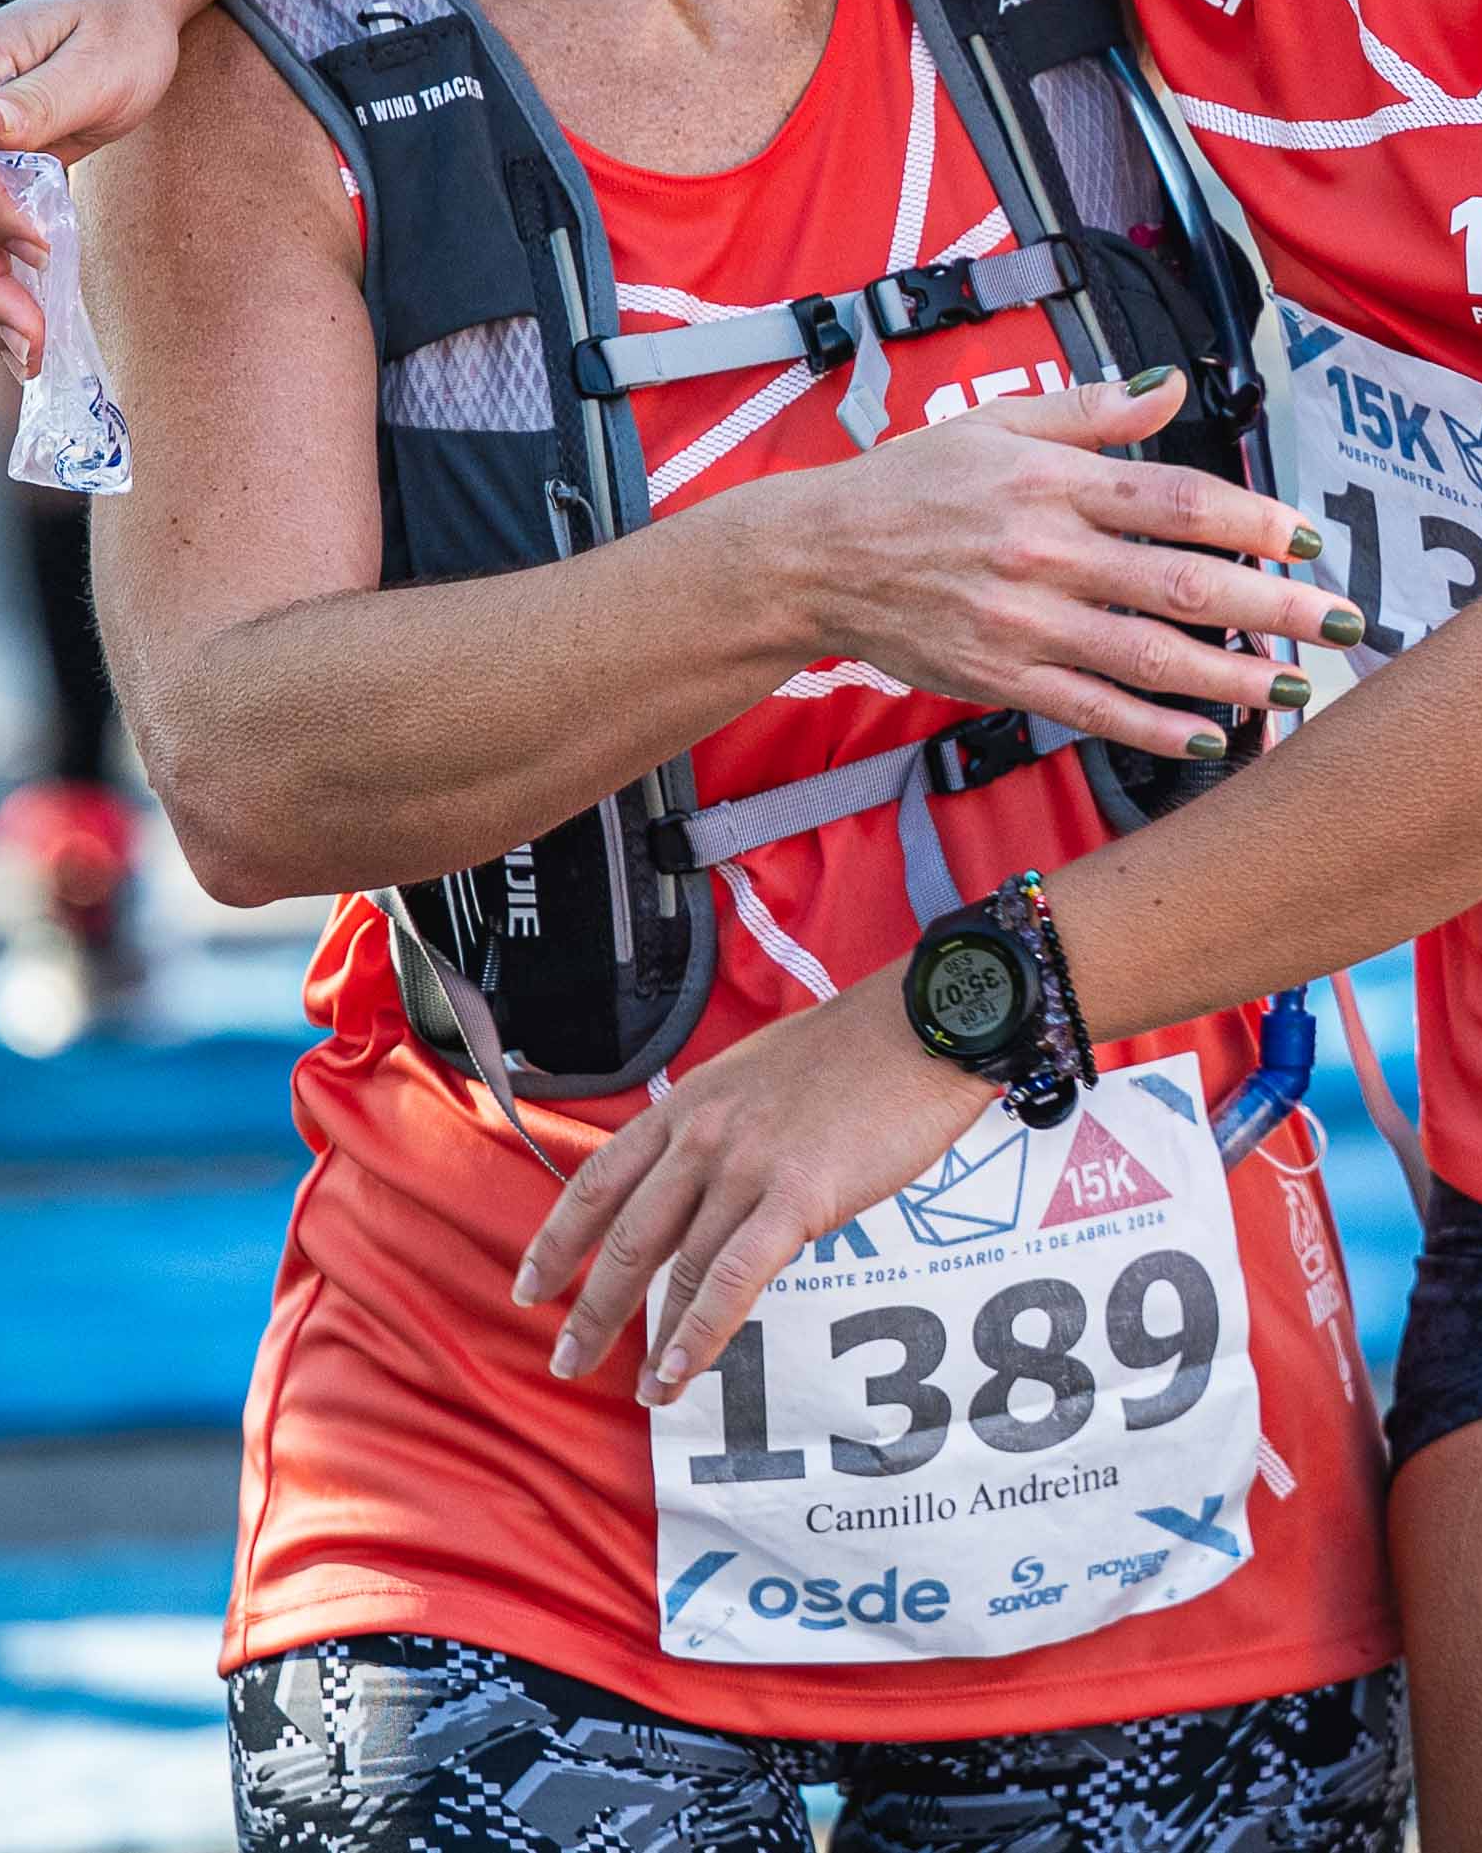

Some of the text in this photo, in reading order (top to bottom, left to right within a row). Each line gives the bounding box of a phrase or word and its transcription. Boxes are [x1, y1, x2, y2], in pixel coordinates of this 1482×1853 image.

[370, 94, 418, 123] WIND
[1326, 364, 1446, 474] 15K
[1338, 441, 1388, 472] PUERTO
[1392, 465, 1434, 492] NORTE
[1437, 482, 1469, 507] 2026
[1063, 1153, 1138, 1209] 15K
[795, 1273, 856, 1292] NORTE
[864, 1265, 908, 1284] 2026
[928, 1248, 1006, 1274] ROSARIO
[1024, 1238, 1043, 1255] 12
[1049, 1233, 1070, 1249] DE
[1075, 1221, 1122, 1244] ABRIL
[1127, 1210, 1166, 1230] 2026
[689, 1248, 1220, 1485] 1389
[805, 1462, 1119, 1535] Cannillo Andreina
[748, 1566, 951, 1630] osde
[1087, 1549, 1170, 1581] POWER
